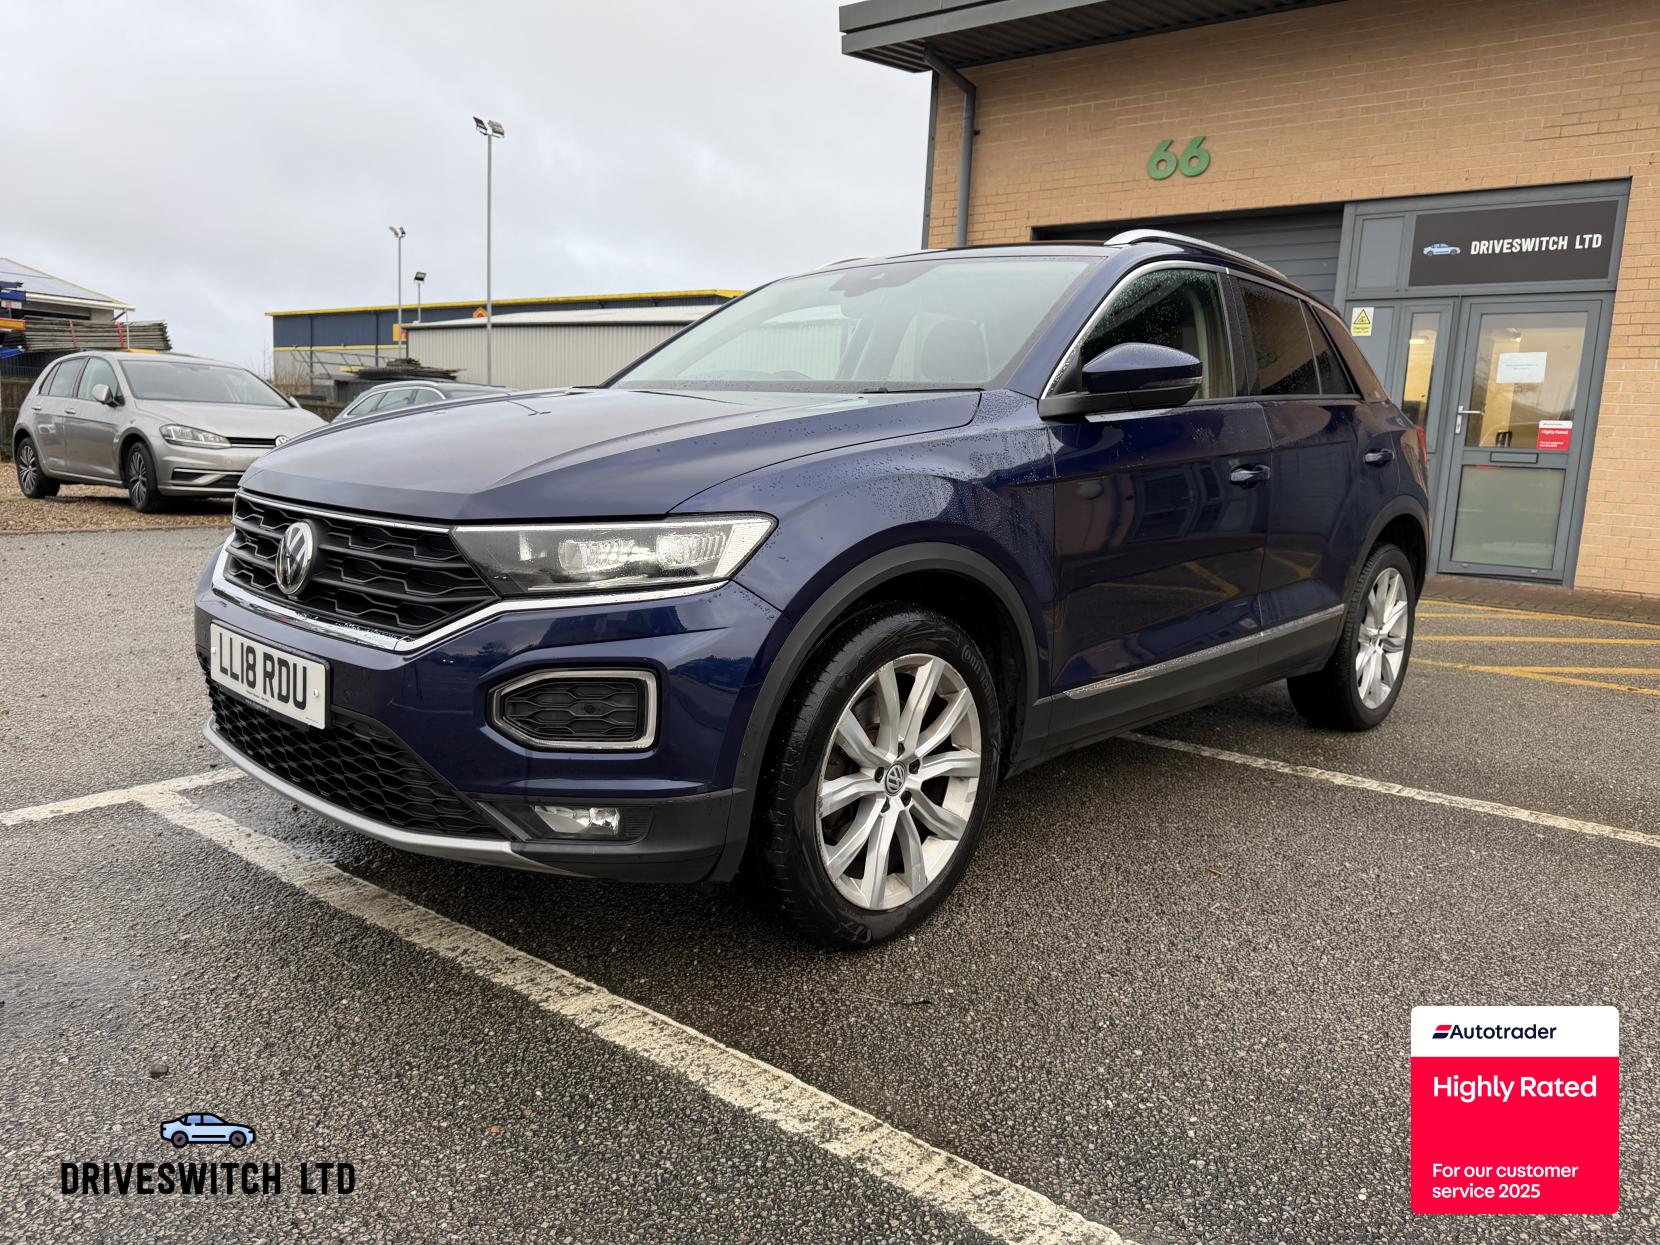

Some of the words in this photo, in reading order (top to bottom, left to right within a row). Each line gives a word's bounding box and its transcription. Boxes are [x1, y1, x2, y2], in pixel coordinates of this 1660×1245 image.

[1147, 136, 1210, 180] 66
[1471, 235, 1569, 254] DRIVESWITCH
[1575, 233, 1603, 250] LTD
[219, 632, 257, 689] LL18
[263, 652, 307, 710] RDU
